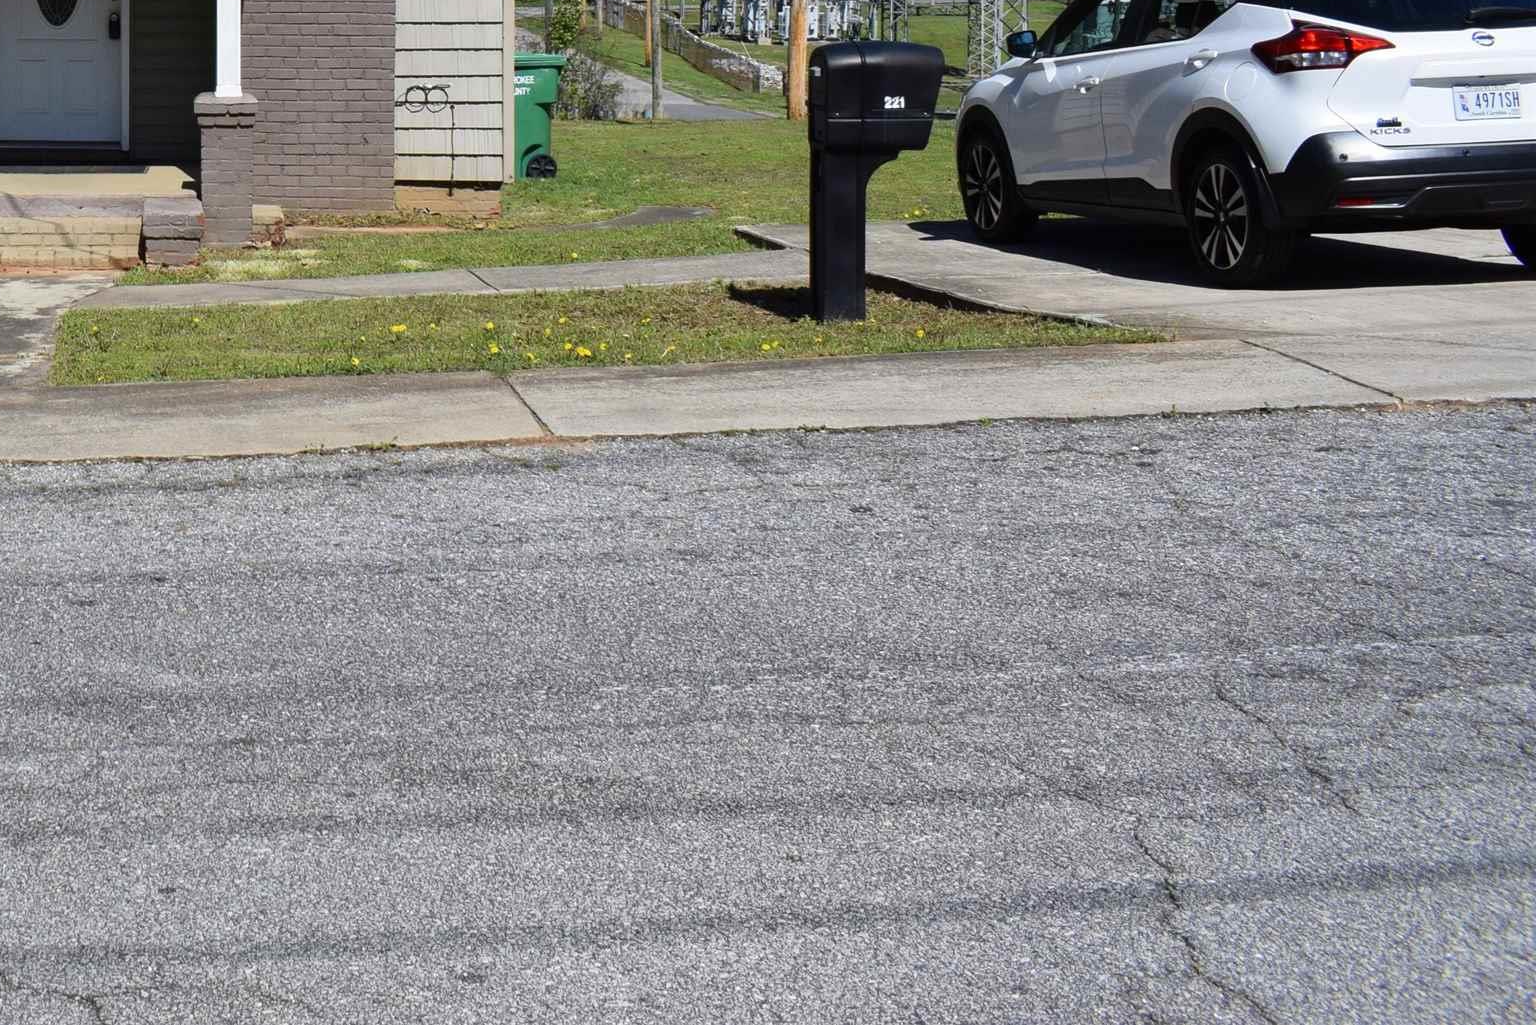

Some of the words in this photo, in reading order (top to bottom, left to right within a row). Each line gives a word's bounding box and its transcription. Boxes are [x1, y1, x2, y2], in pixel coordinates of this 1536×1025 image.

[884, 96, 905, 109] 221
[1475, 91, 1521, 109] 4971SH
[1369, 128, 1411, 136] KICKS
